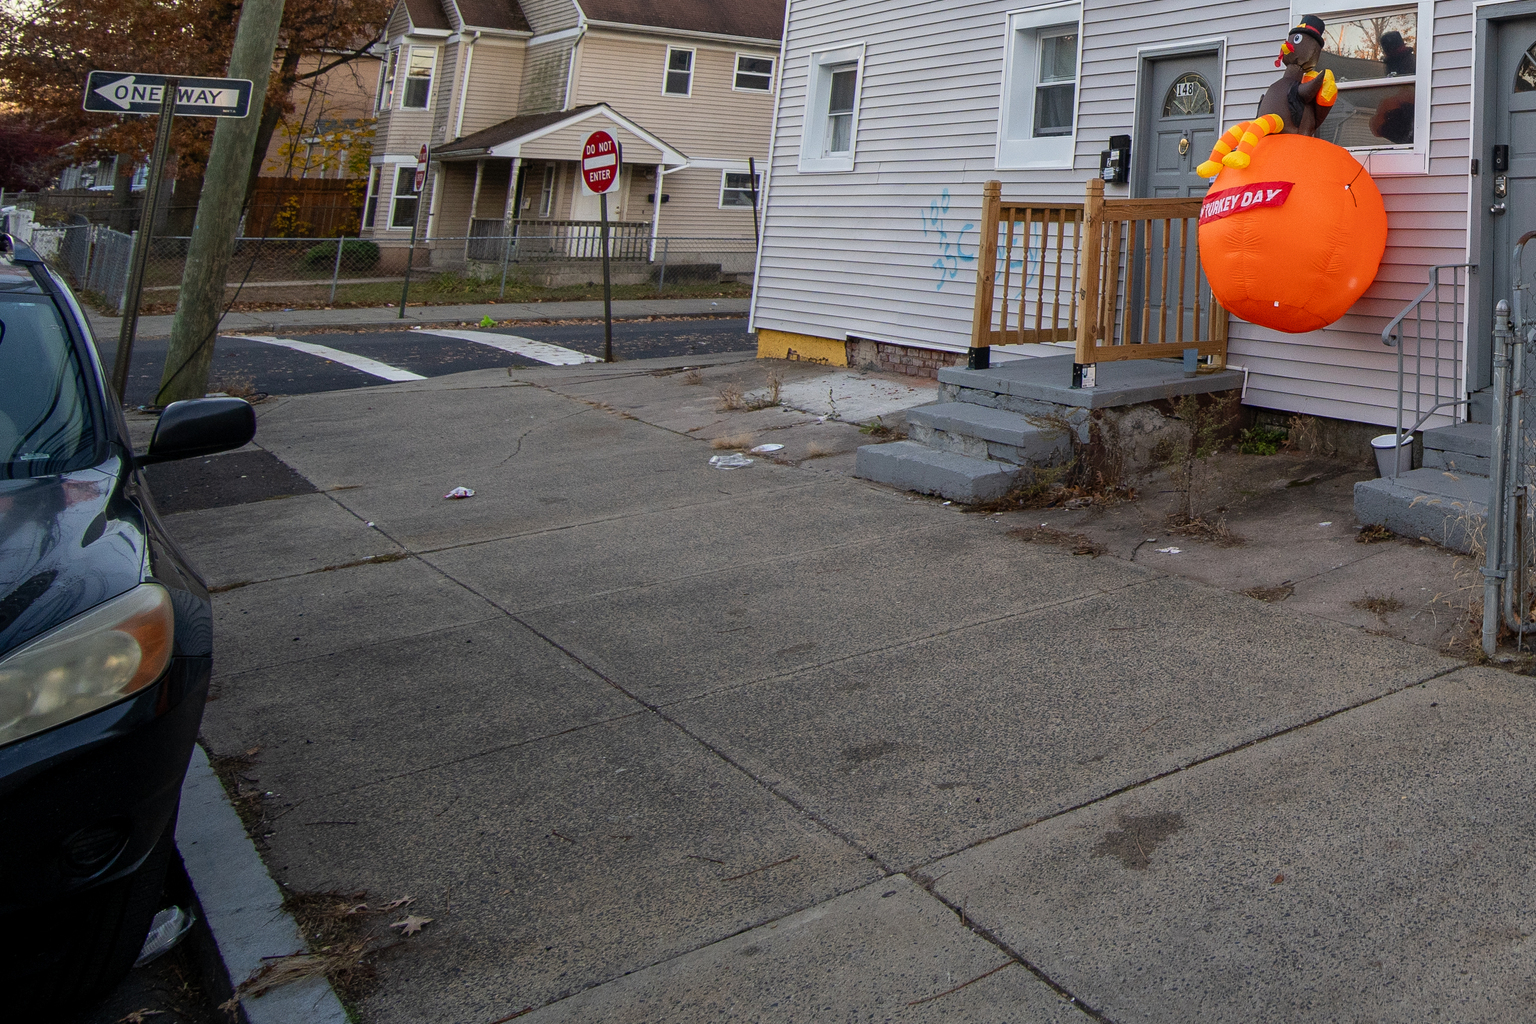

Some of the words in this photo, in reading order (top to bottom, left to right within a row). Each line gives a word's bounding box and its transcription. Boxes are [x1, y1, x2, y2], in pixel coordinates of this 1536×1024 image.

[114, 84, 162, 102] ONE
[177, 88, 223, 104] WAY
[1177, 83, 1193, 96] 148
[586, 144, 596, 155] DO
[599, 140, 612, 153] NOT
[589, 169, 611, 182] ENTER
[1204, 194, 1241, 218] TURKEY
[1240, 188, 1283, 207] DAY
